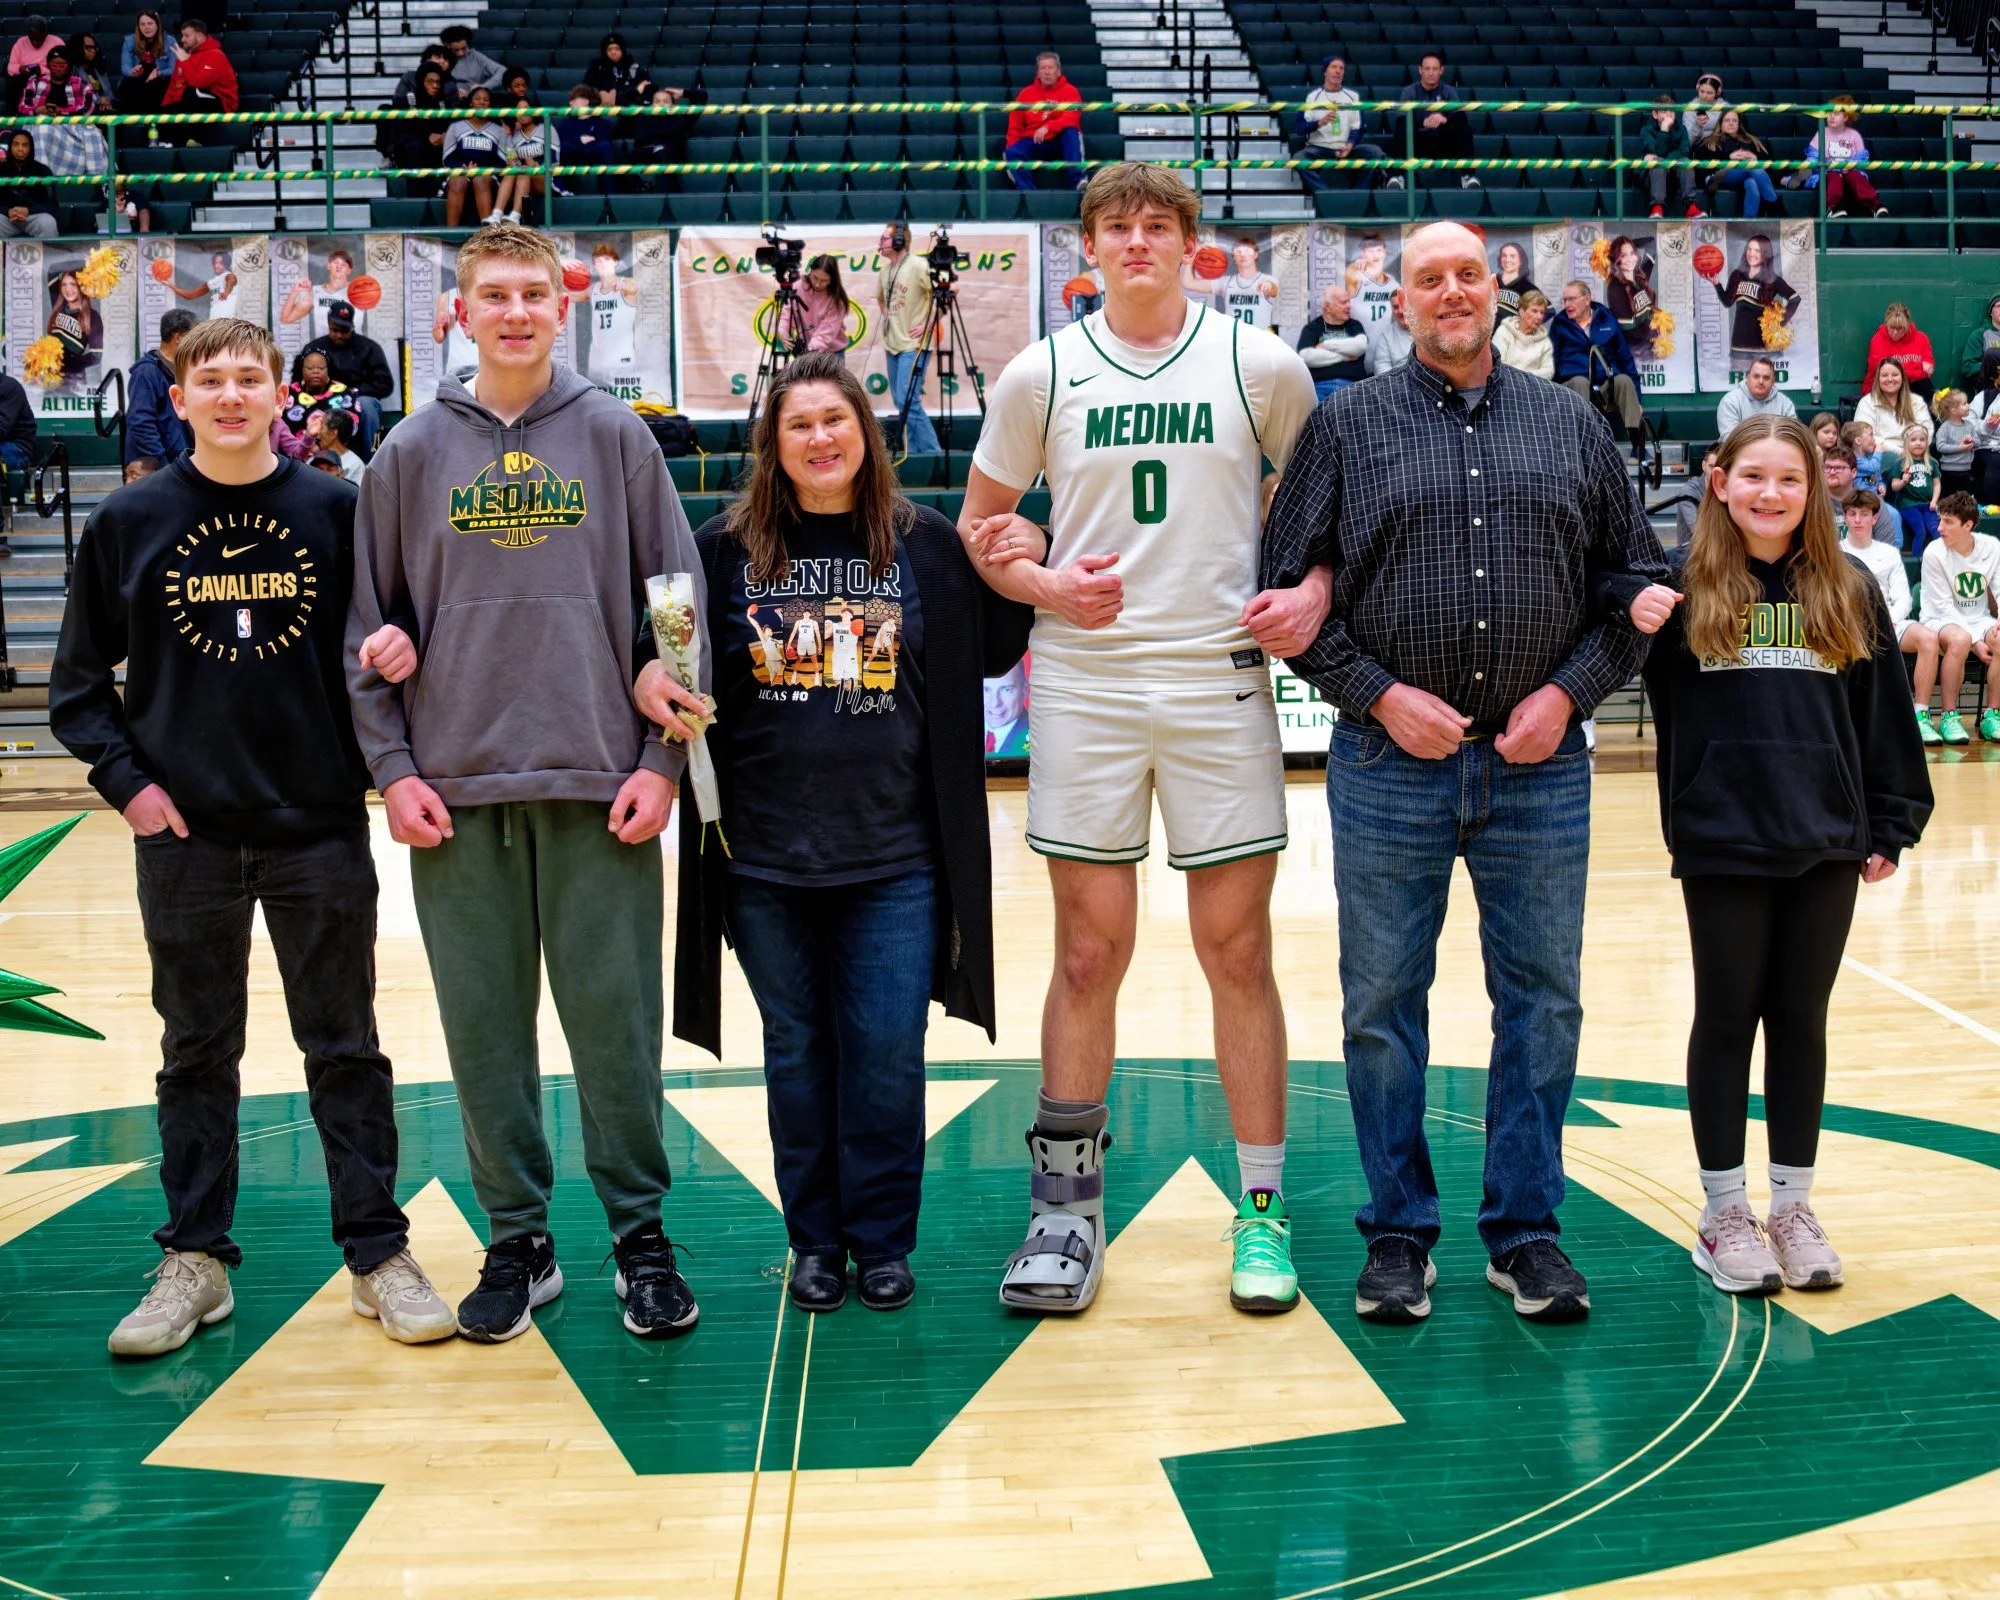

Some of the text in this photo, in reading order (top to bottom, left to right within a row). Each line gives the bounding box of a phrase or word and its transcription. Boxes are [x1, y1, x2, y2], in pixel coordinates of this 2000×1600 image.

[463, 137, 492, 151] TITANS
[1546, 239, 1560, 251] 26
[1670, 239, 1685, 251] 26
[245, 253, 261, 265] 26
[378, 251, 395, 263] 26
[12, 267, 33, 310] BEES
[1364, 291, 1391, 301] MEDIN
[1229, 293, 1259, 305] MEDINA
[411, 260, 433, 376] MEDINA BEES
[600, 314, 612, 329] 13
[1641, 364, 1664, 372] BELLA
[614, 377, 641, 386] BRODY
[1085, 402, 1214, 449] MEDINA
[450, 480, 586, 518] MEDINA
[1132, 460, 1166, 524] 0
[469, 516, 567, 528] BASKETBALL
[177, 513, 290, 556] CAVALIERS
[187, 572, 297, 602] CAVALIERS
[1957, 572, 1985, 598] M
[255, 548, 317, 659] BASKETBALL
[165, 570, 238, 662] CLEVELAND
[792, 689, 809, 701] #0
[834, 677, 897, 715] Mom
